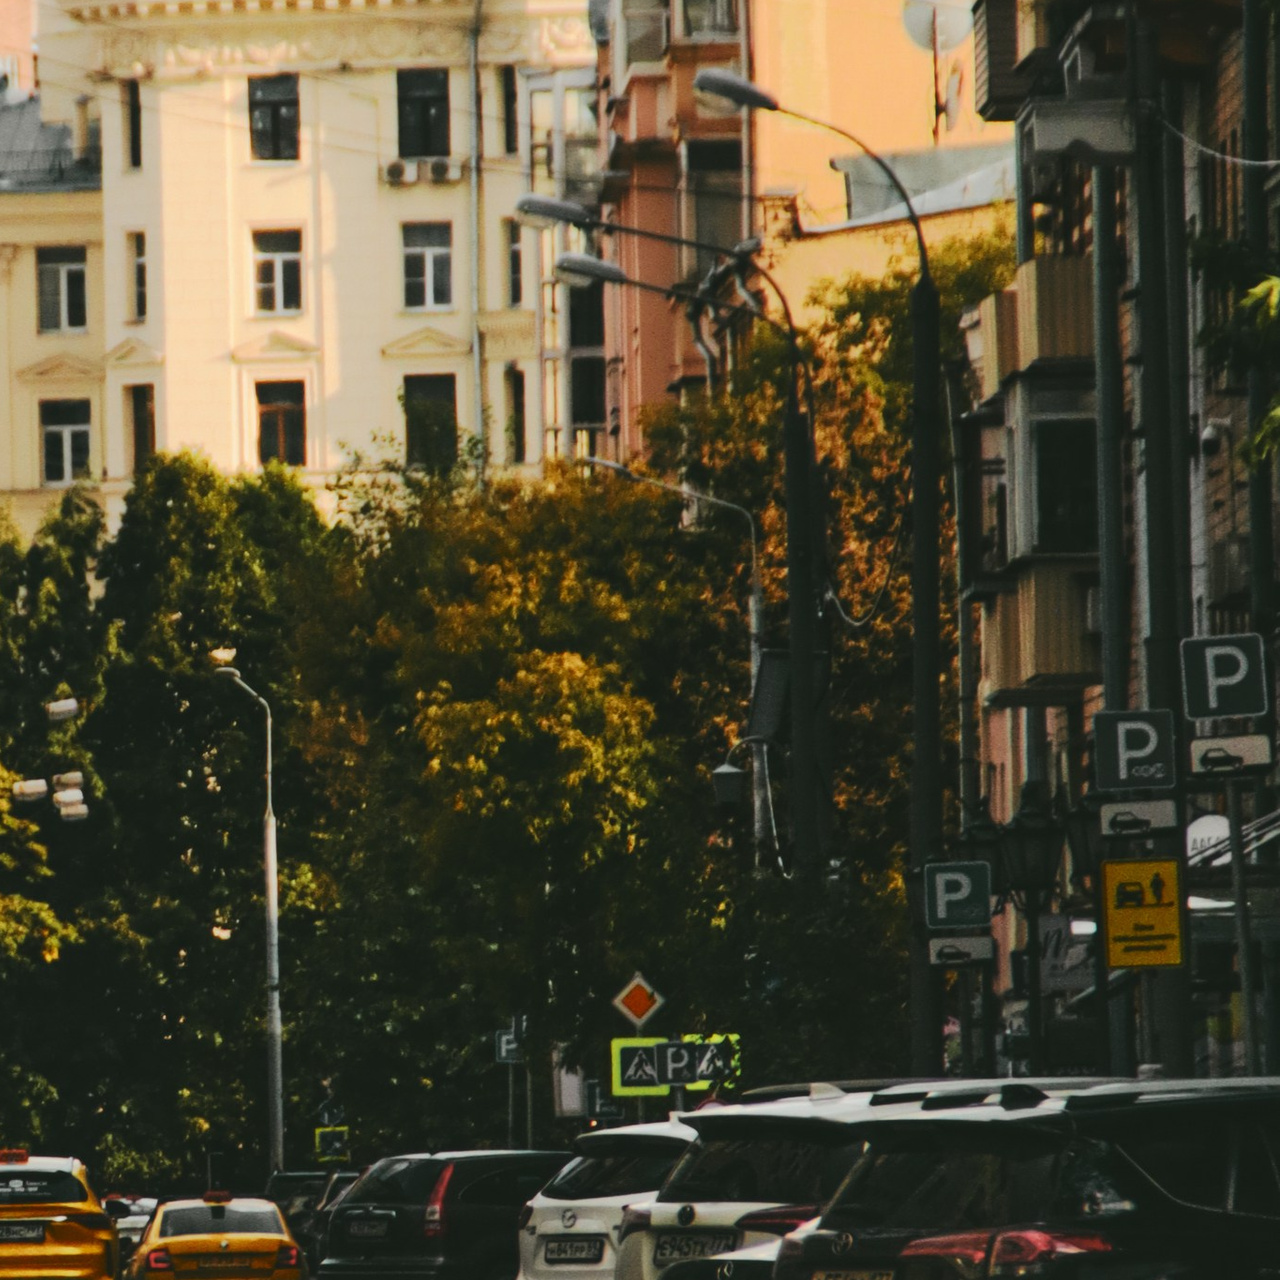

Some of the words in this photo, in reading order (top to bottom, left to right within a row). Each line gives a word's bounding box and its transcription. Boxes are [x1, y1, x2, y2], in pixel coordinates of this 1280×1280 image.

[1204, 645, 1249, 709] P
[1117, 720, 1159, 780] P
[934, 872, 972, 919] P
[667, 1047, 689, 1079] P
